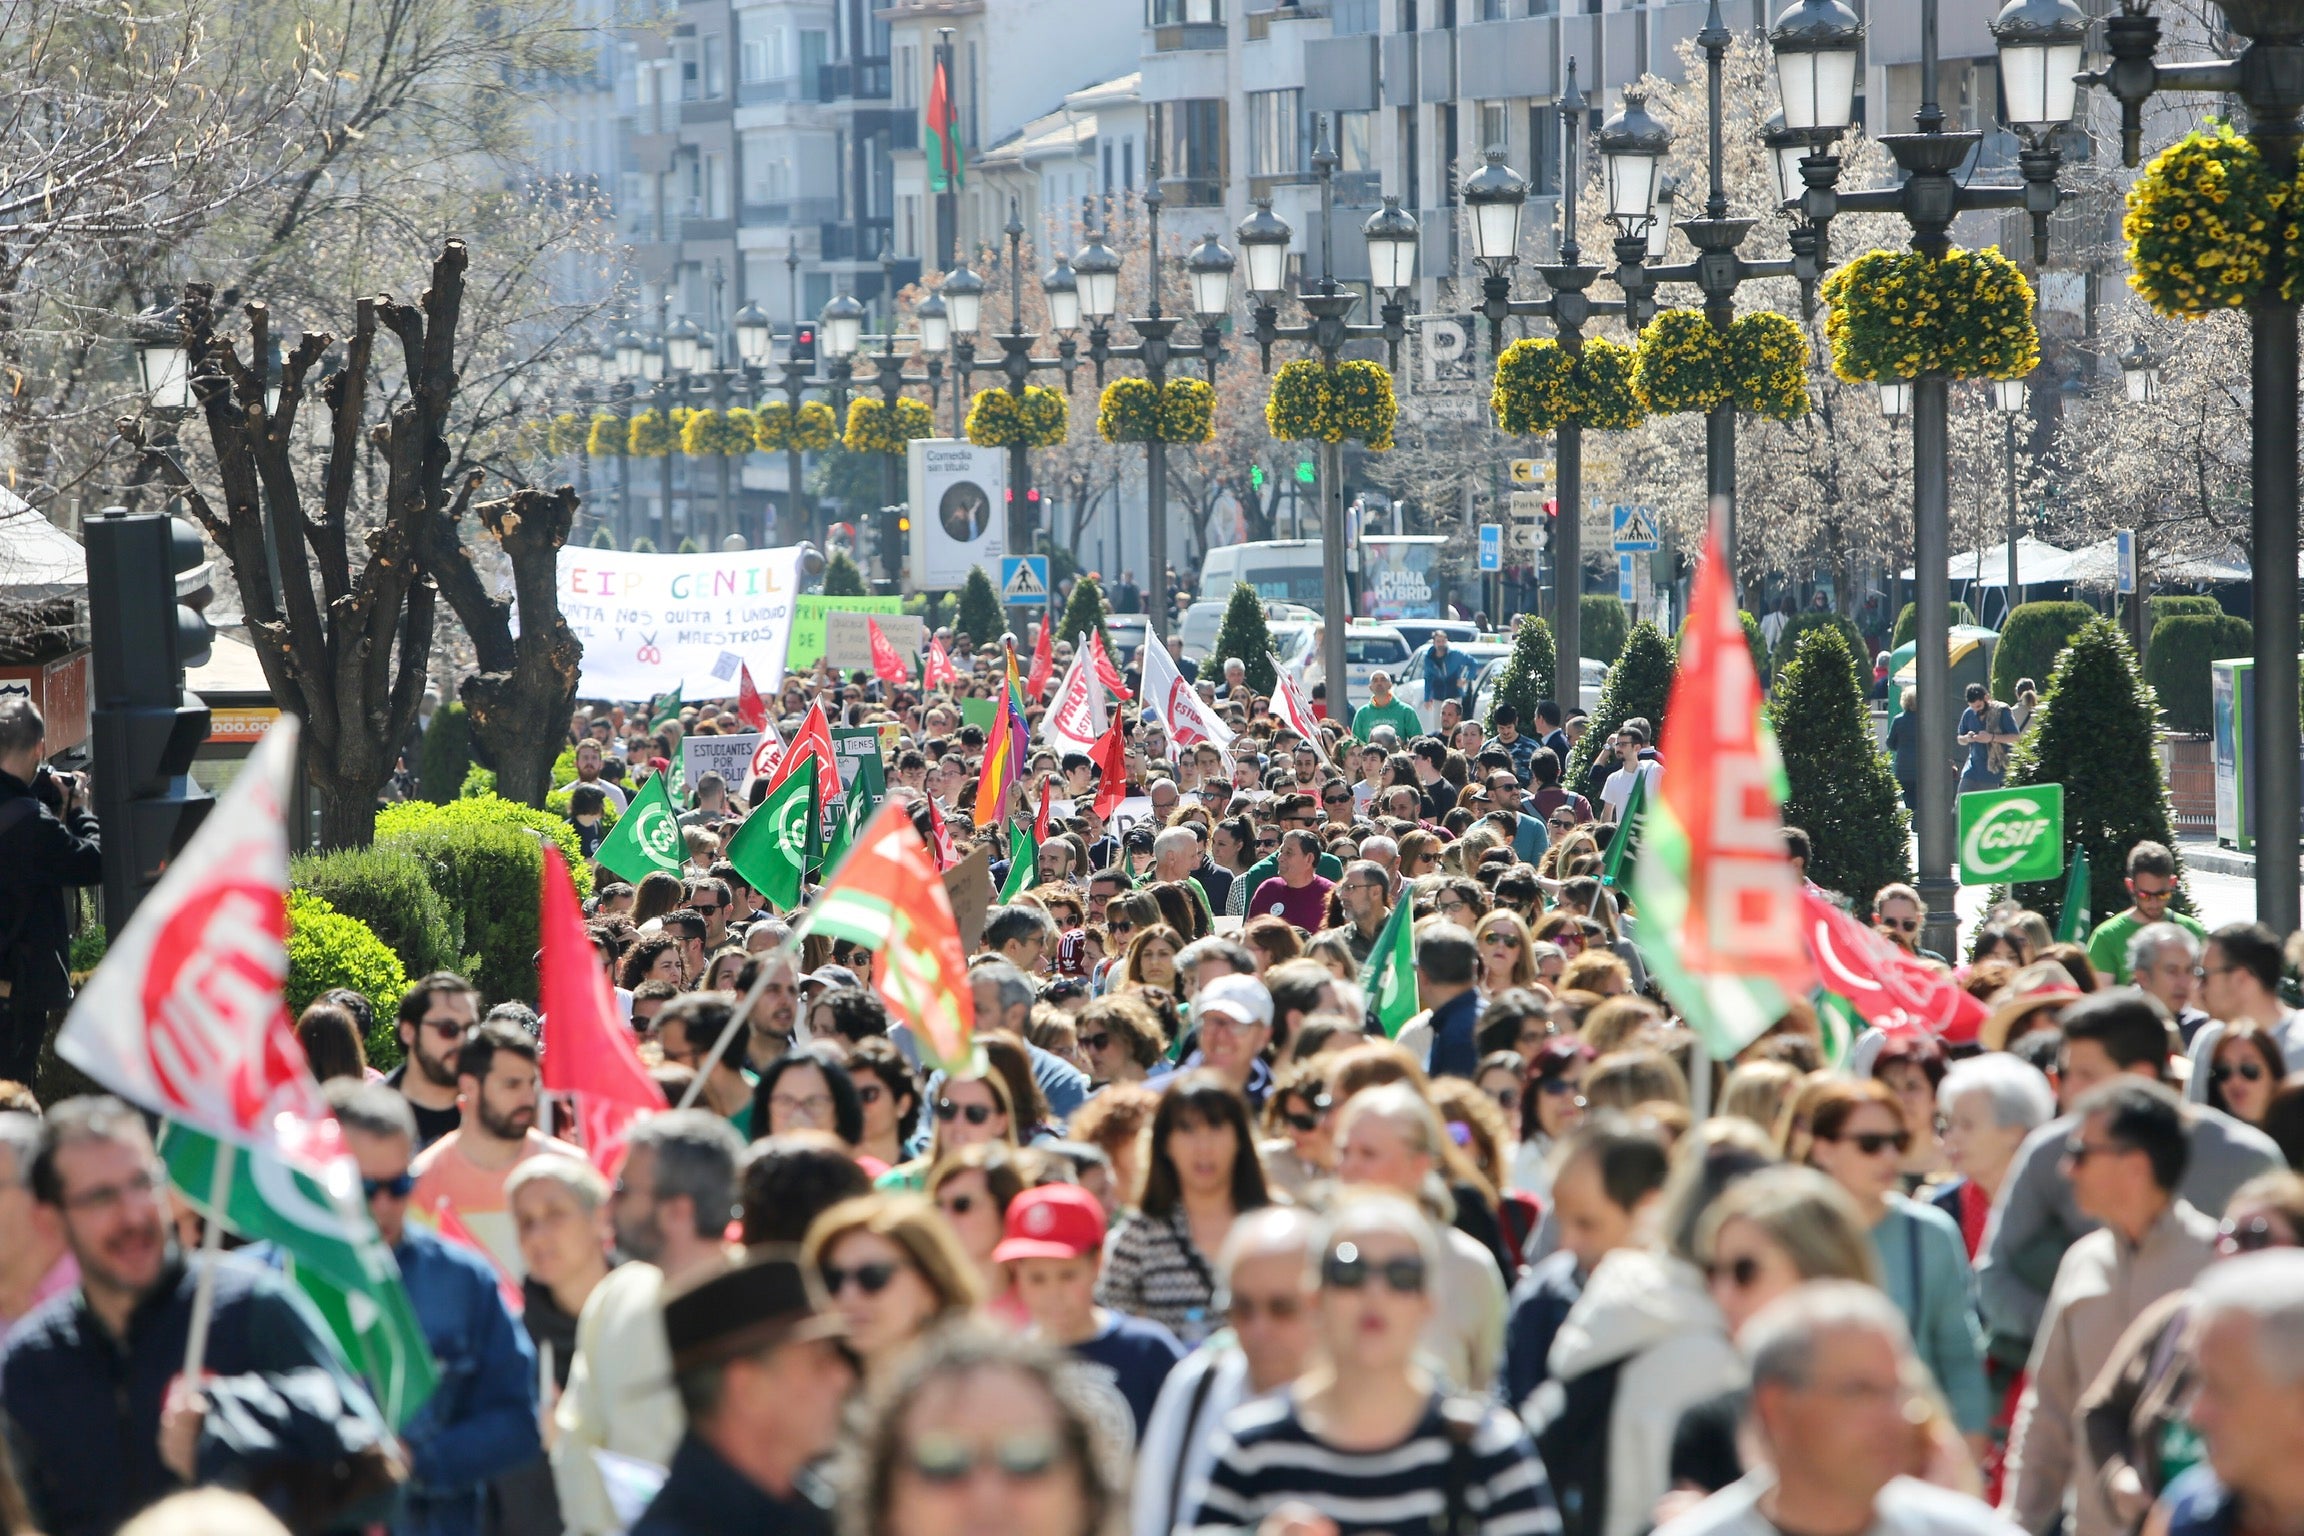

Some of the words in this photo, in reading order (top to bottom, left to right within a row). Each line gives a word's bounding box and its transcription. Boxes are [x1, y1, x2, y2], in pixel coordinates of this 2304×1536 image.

[926, 450, 973, 461] Comedia
[557, 568, 642, 596] EIP
[671, 567, 782, 599] GENIL
[1380, 571, 1428, 586] PUMA
[1375, 585, 1432, 601] HYBRID
[665, 608, 711, 624] QUITA
[615, 627, 626, 641] Y
[678, 626, 773, 645] MAESTROS
[694, 742, 753, 758] ESTUDIANTES
[847, 740, 875, 751] TIENES
[713, 756, 733, 768] POR
[1980, 818, 2051, 850] CSIF
